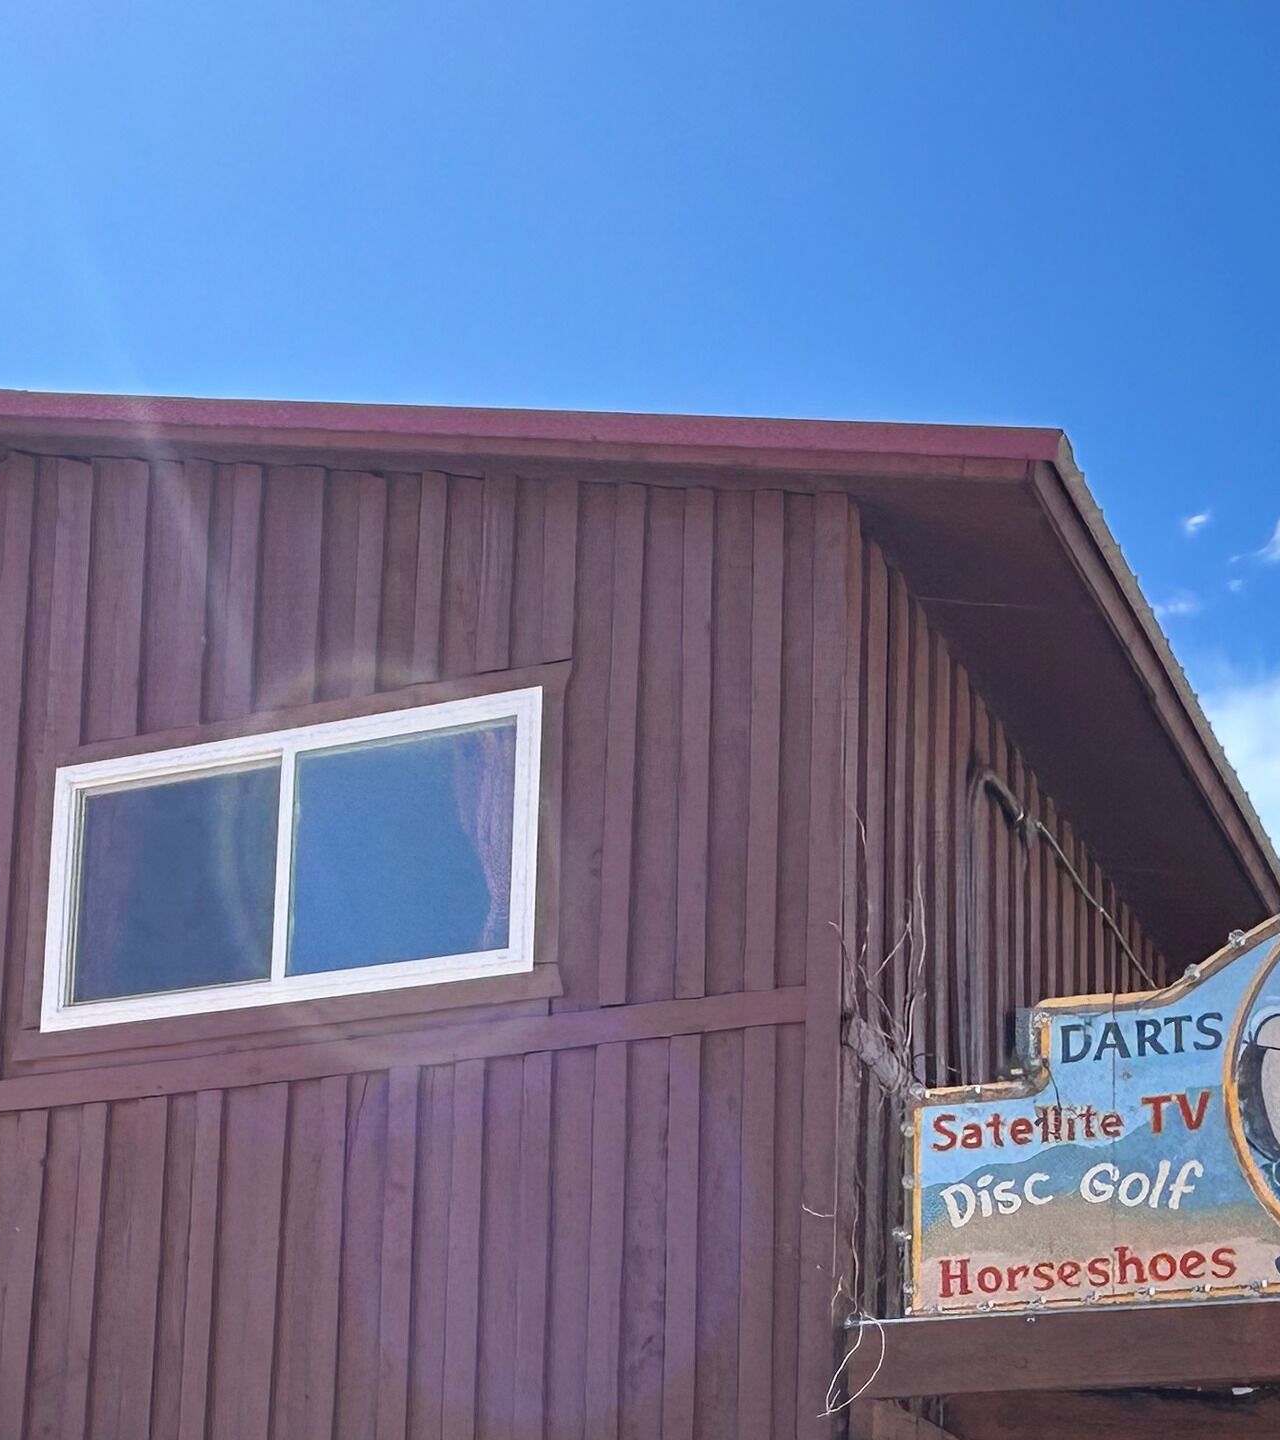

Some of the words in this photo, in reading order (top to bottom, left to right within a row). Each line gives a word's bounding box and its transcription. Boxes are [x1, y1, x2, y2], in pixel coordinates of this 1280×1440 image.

[1059, 1011, 1224, 1065] DARTS
[931, 1103, 1125, 1152] Satellite
[1140, 1090, 1213, 1134] TV
[940, 1172, 1055, 1229] Disc
[1080, 1159, 1205, 1211] Golf
[937, 1245, 1238, 1298] Horseshoes
